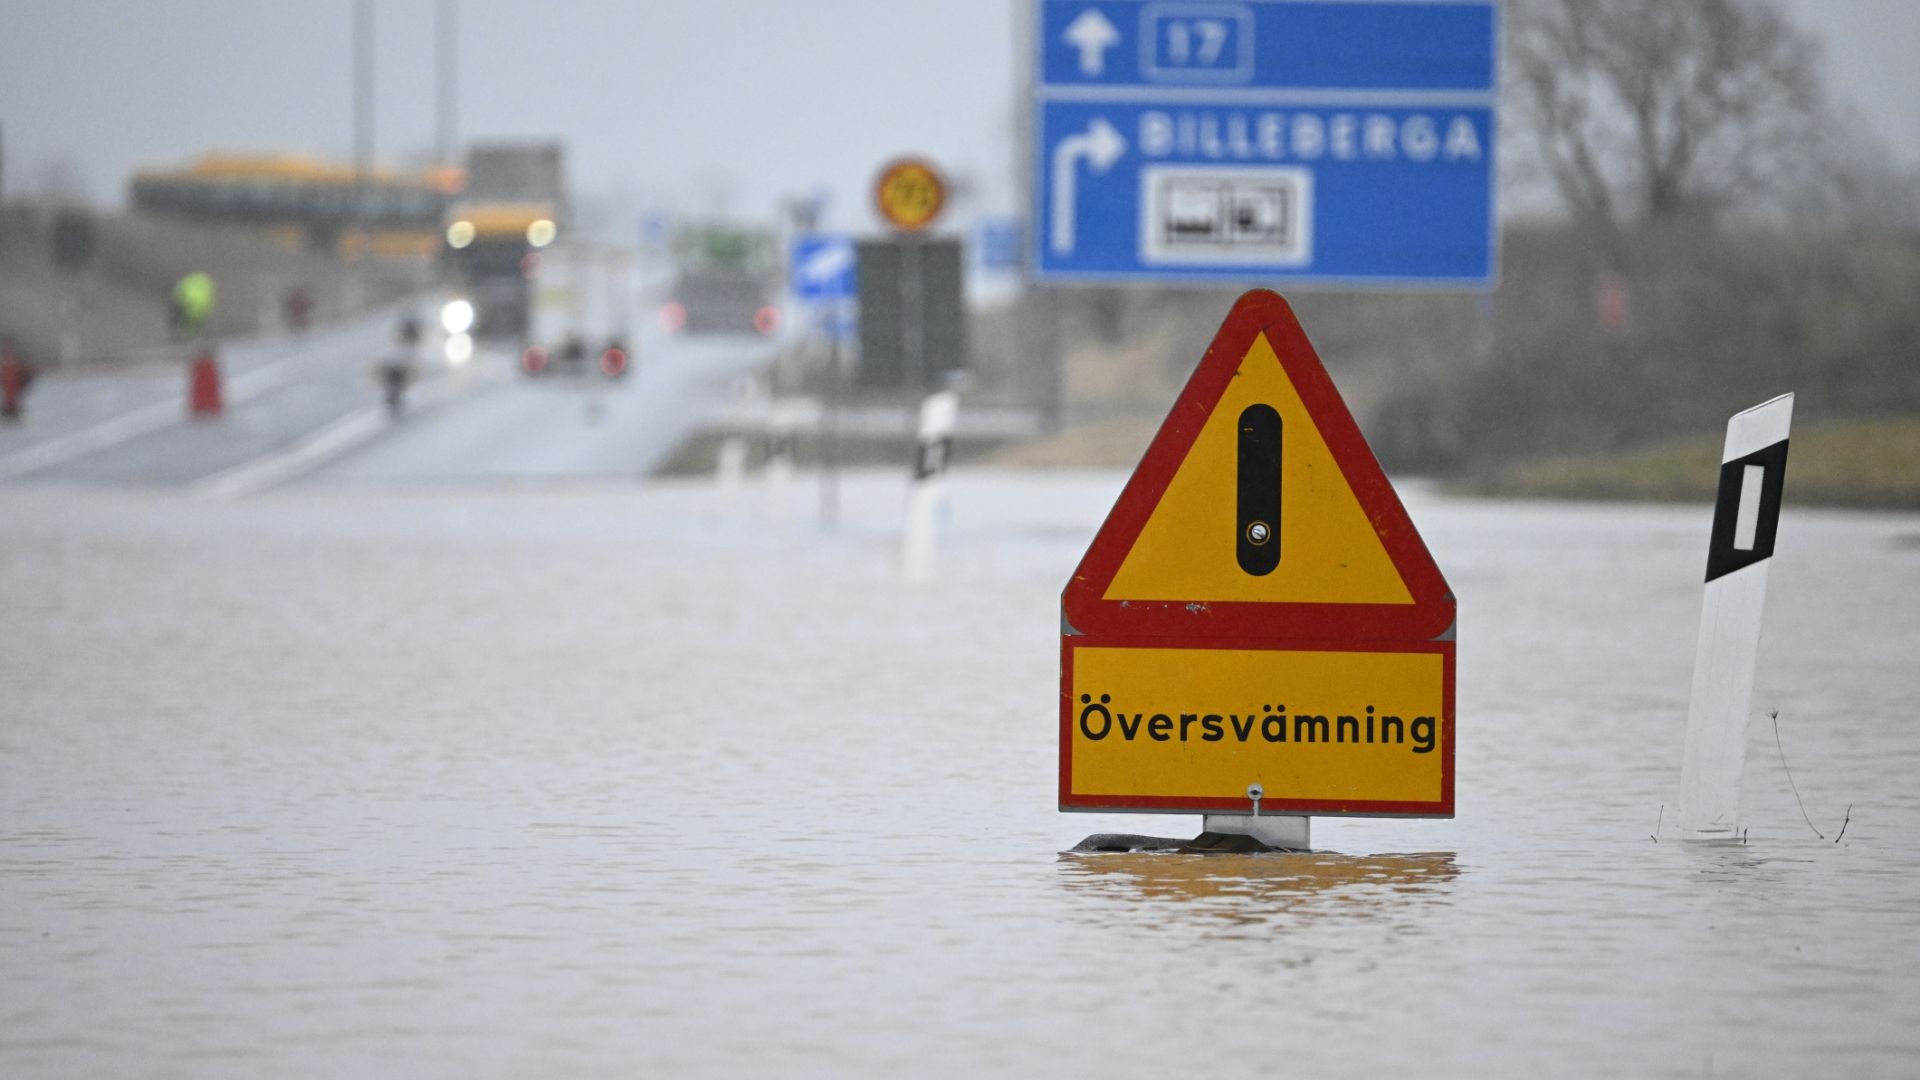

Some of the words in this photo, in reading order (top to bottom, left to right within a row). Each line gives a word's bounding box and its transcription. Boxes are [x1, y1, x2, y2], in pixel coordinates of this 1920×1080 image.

[1167, 20, 1227, 65] 17
[1138, 112, 1481, 160] BILLEBERGA
[1079, 693, 1436, 754] Översvämning
